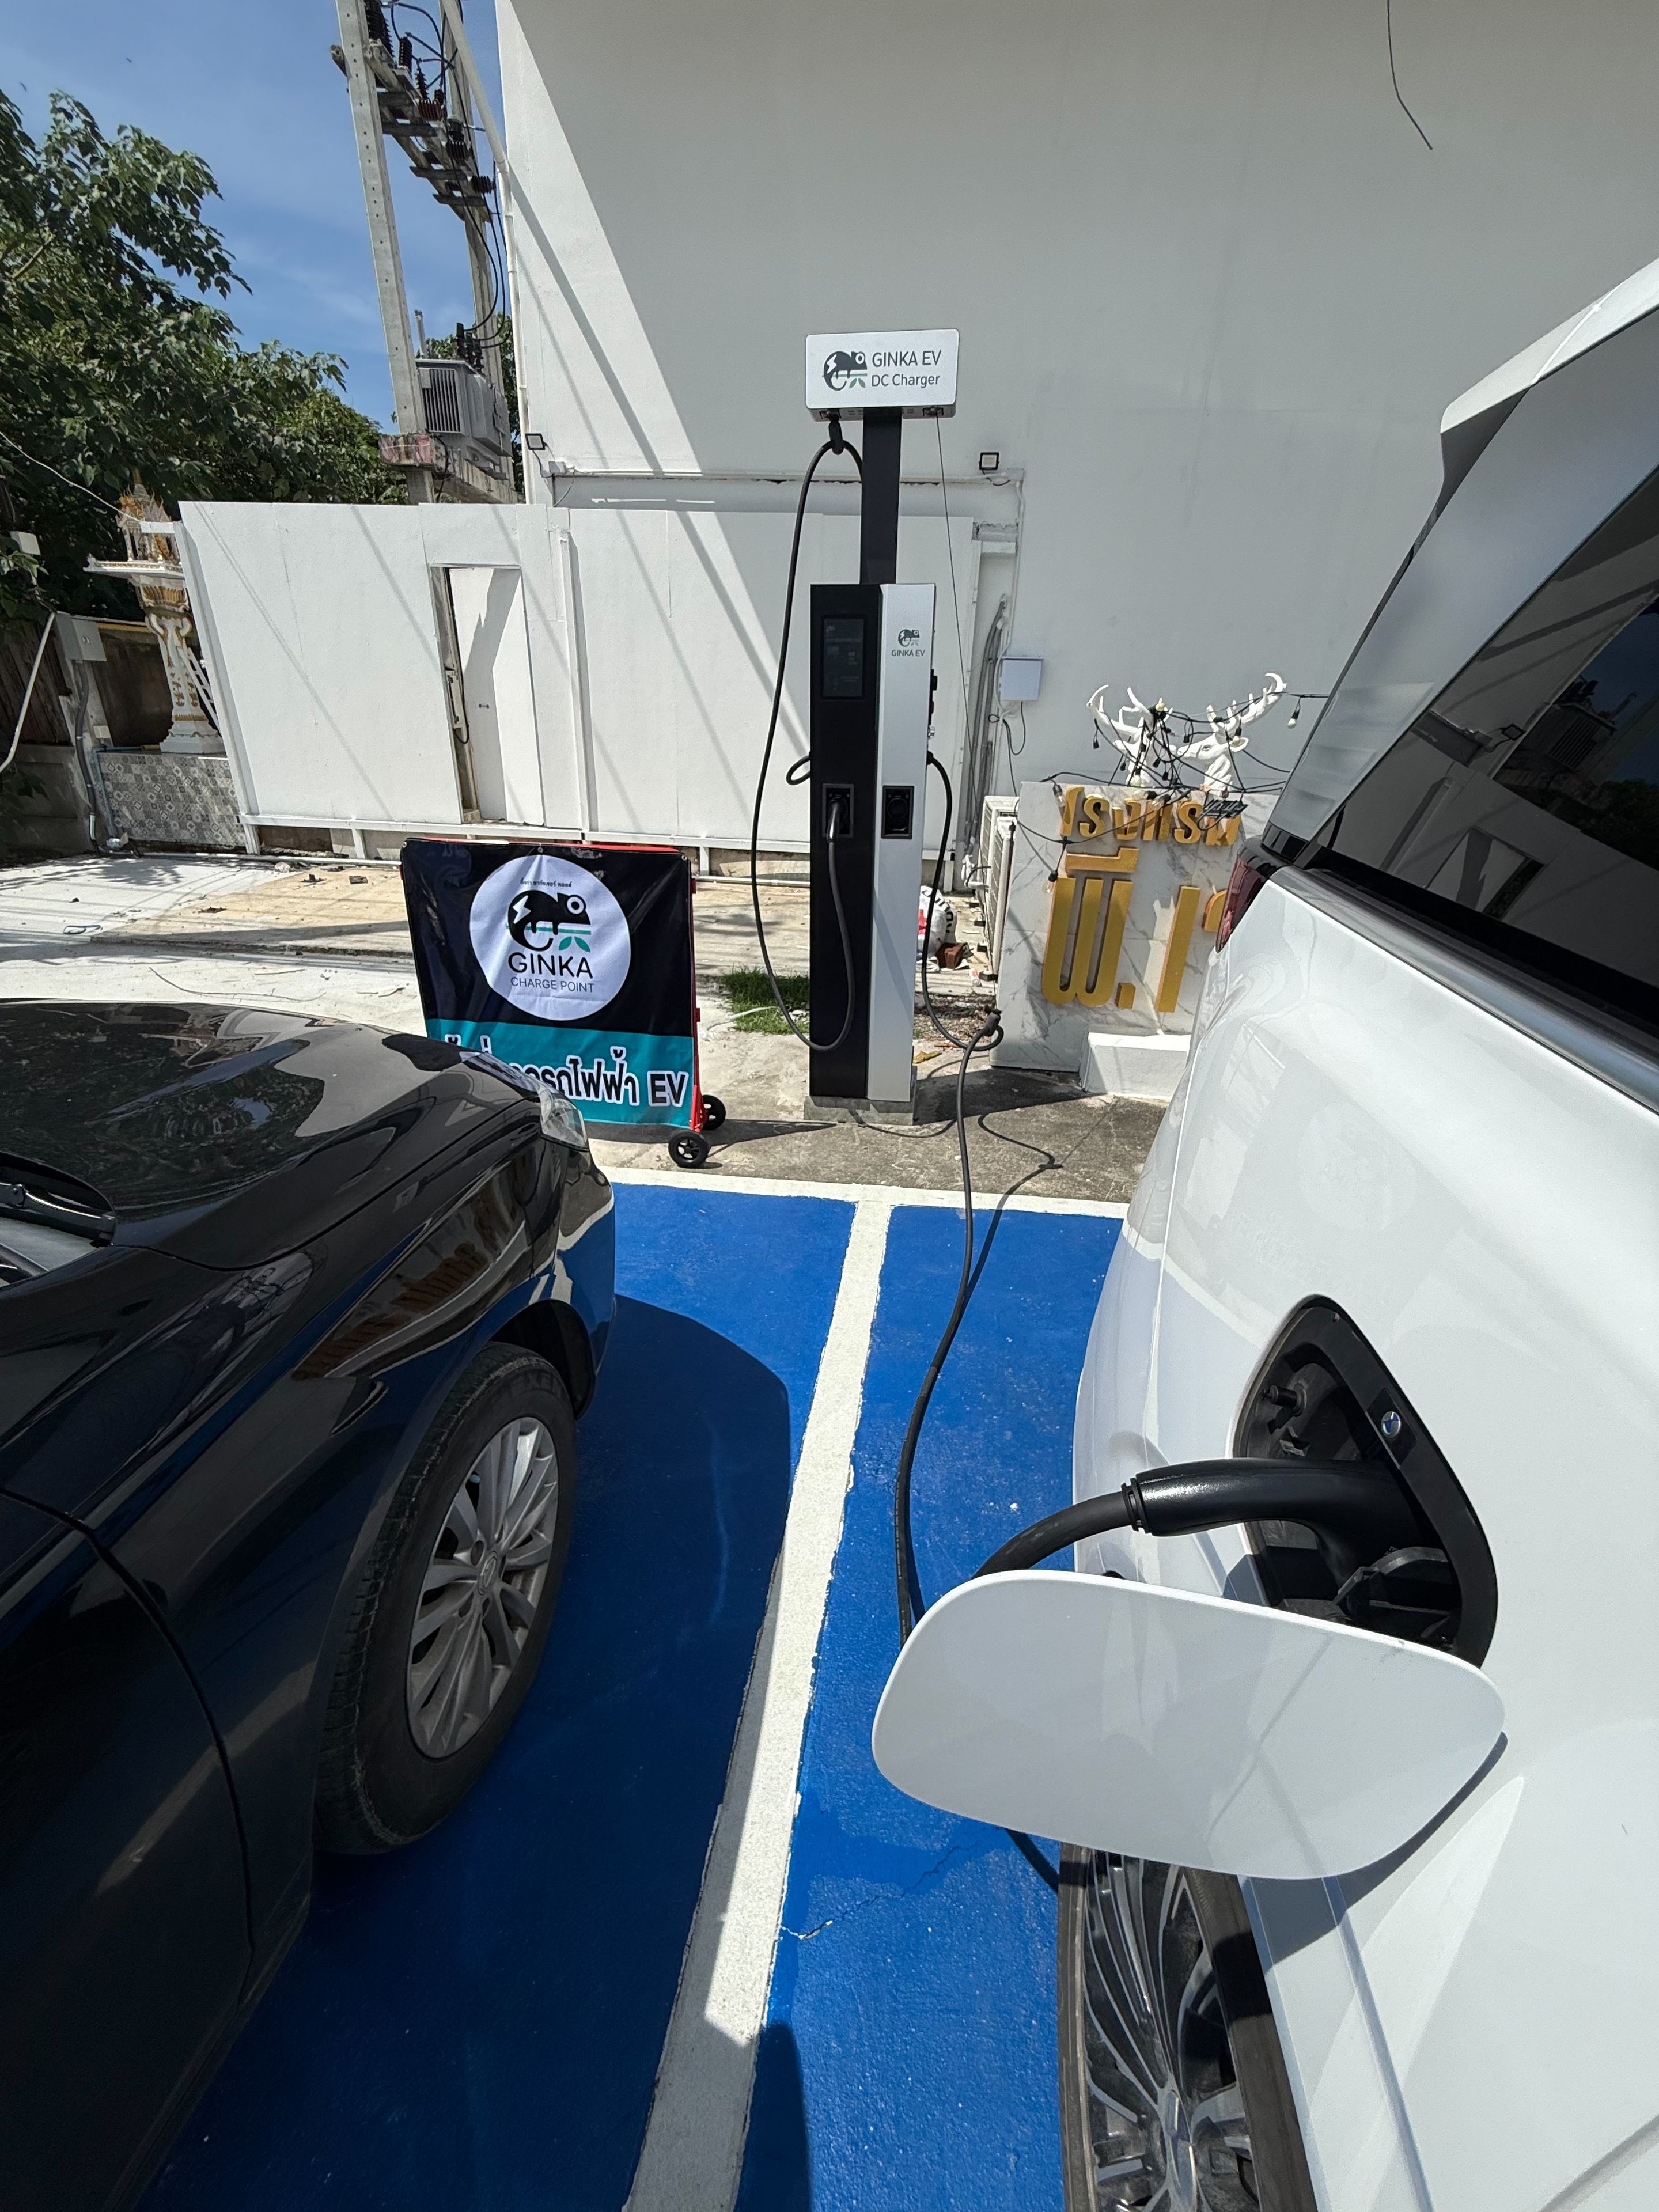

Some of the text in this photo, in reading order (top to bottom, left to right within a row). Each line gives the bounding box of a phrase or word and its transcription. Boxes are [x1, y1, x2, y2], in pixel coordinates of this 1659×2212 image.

[872, 350, 942, 368] GINKA EV
[871, 373, 941, 388] DC Charger
[508, 952, 593, 979] GINKA
[510, 976, 594, 993] CHARGE POINT
[649, 1073, 687, 1104] EV
